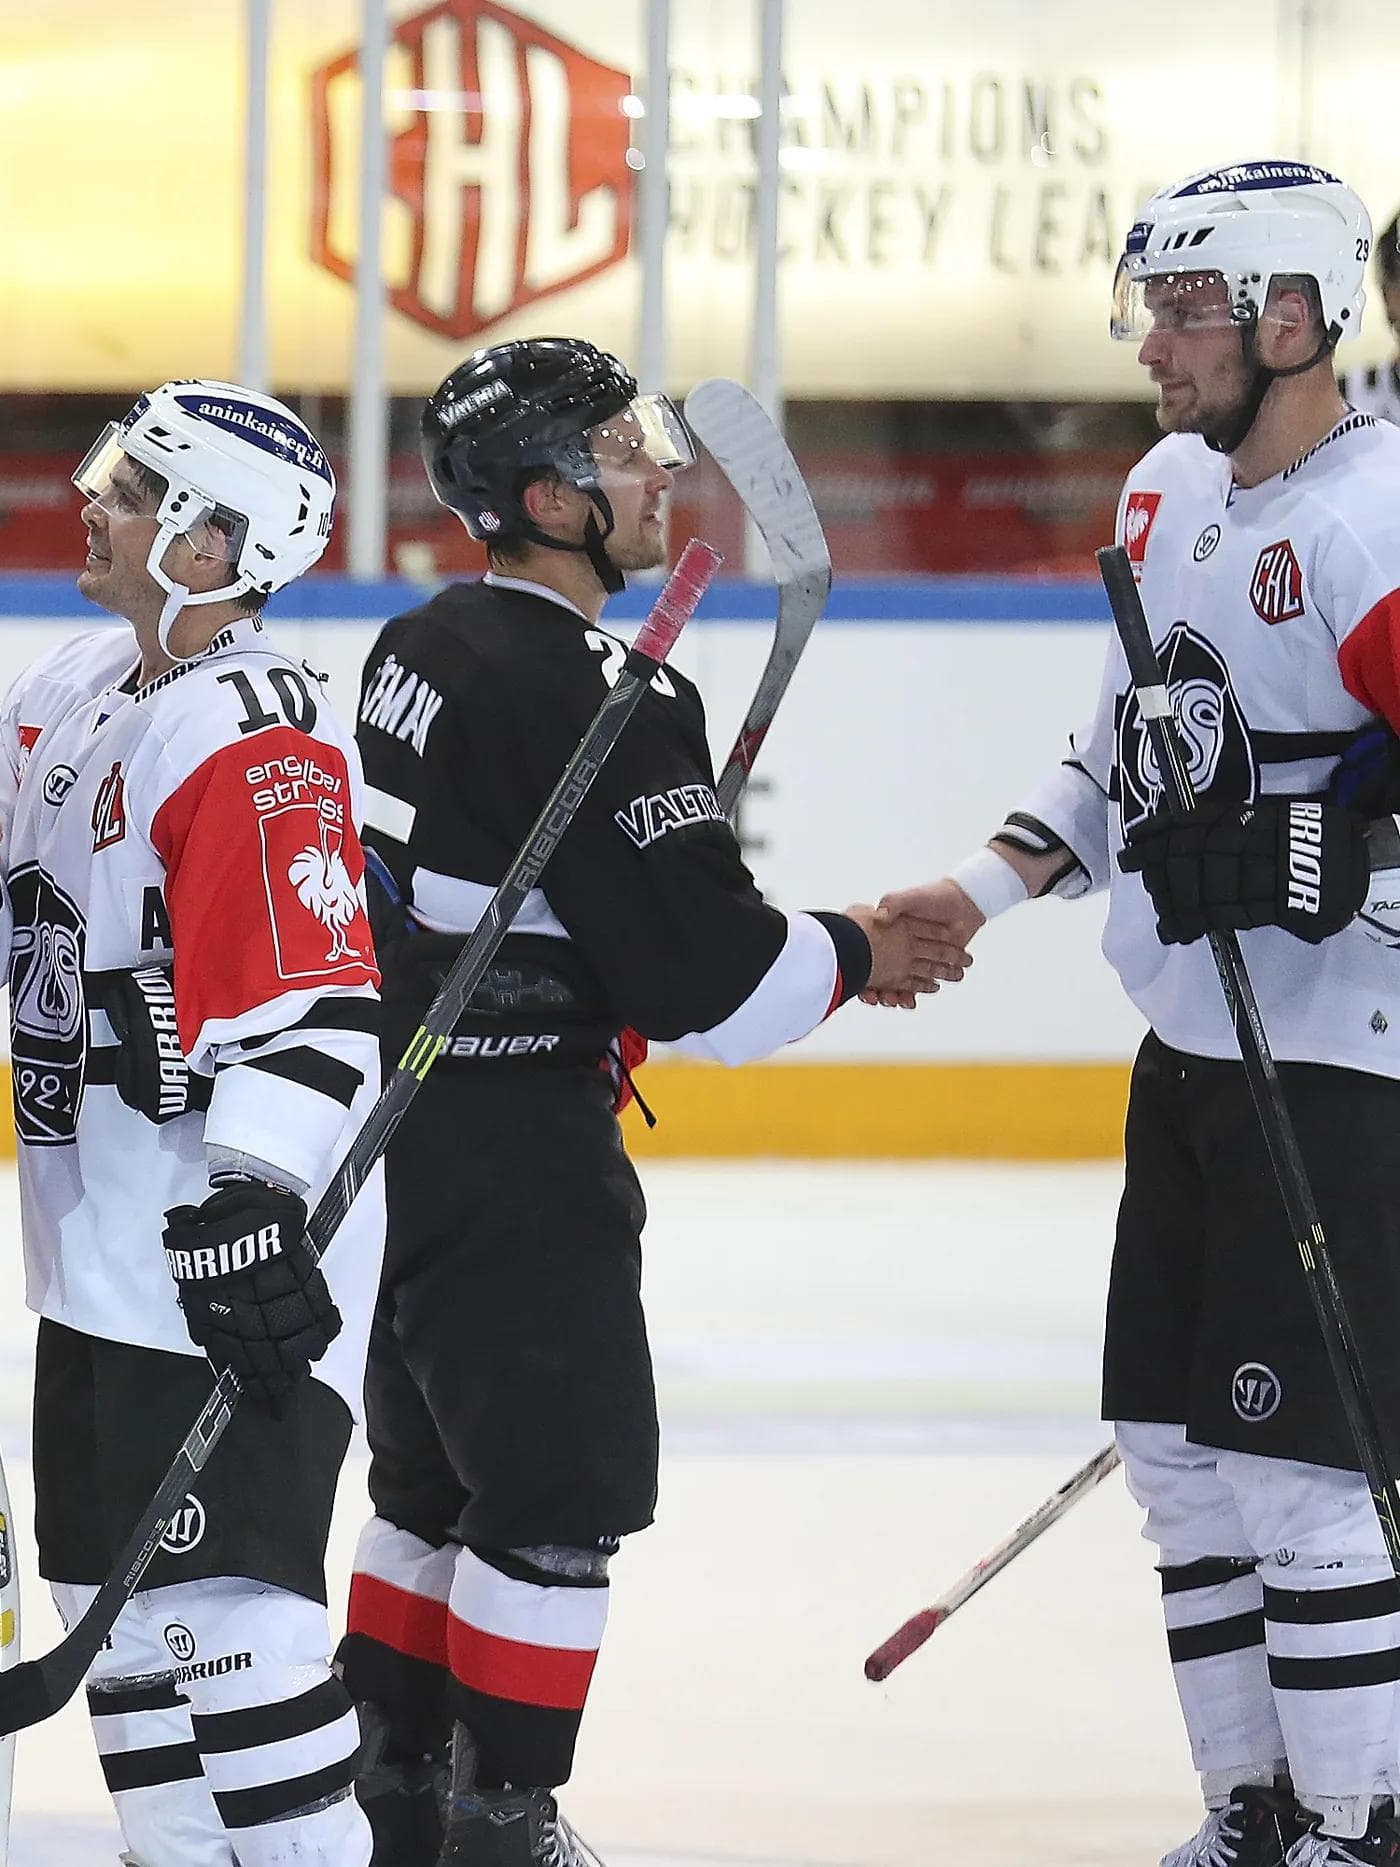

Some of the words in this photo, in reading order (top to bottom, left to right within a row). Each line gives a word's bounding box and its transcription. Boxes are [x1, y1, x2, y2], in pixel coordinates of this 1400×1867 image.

[322, 14, 618, 320] CHL
[1356, 238, 1370, 262] 29
[1253, 547, 1300, 617] CHL
[216, 667, 318, 735] 10
[141, 886, 173, 951] A
